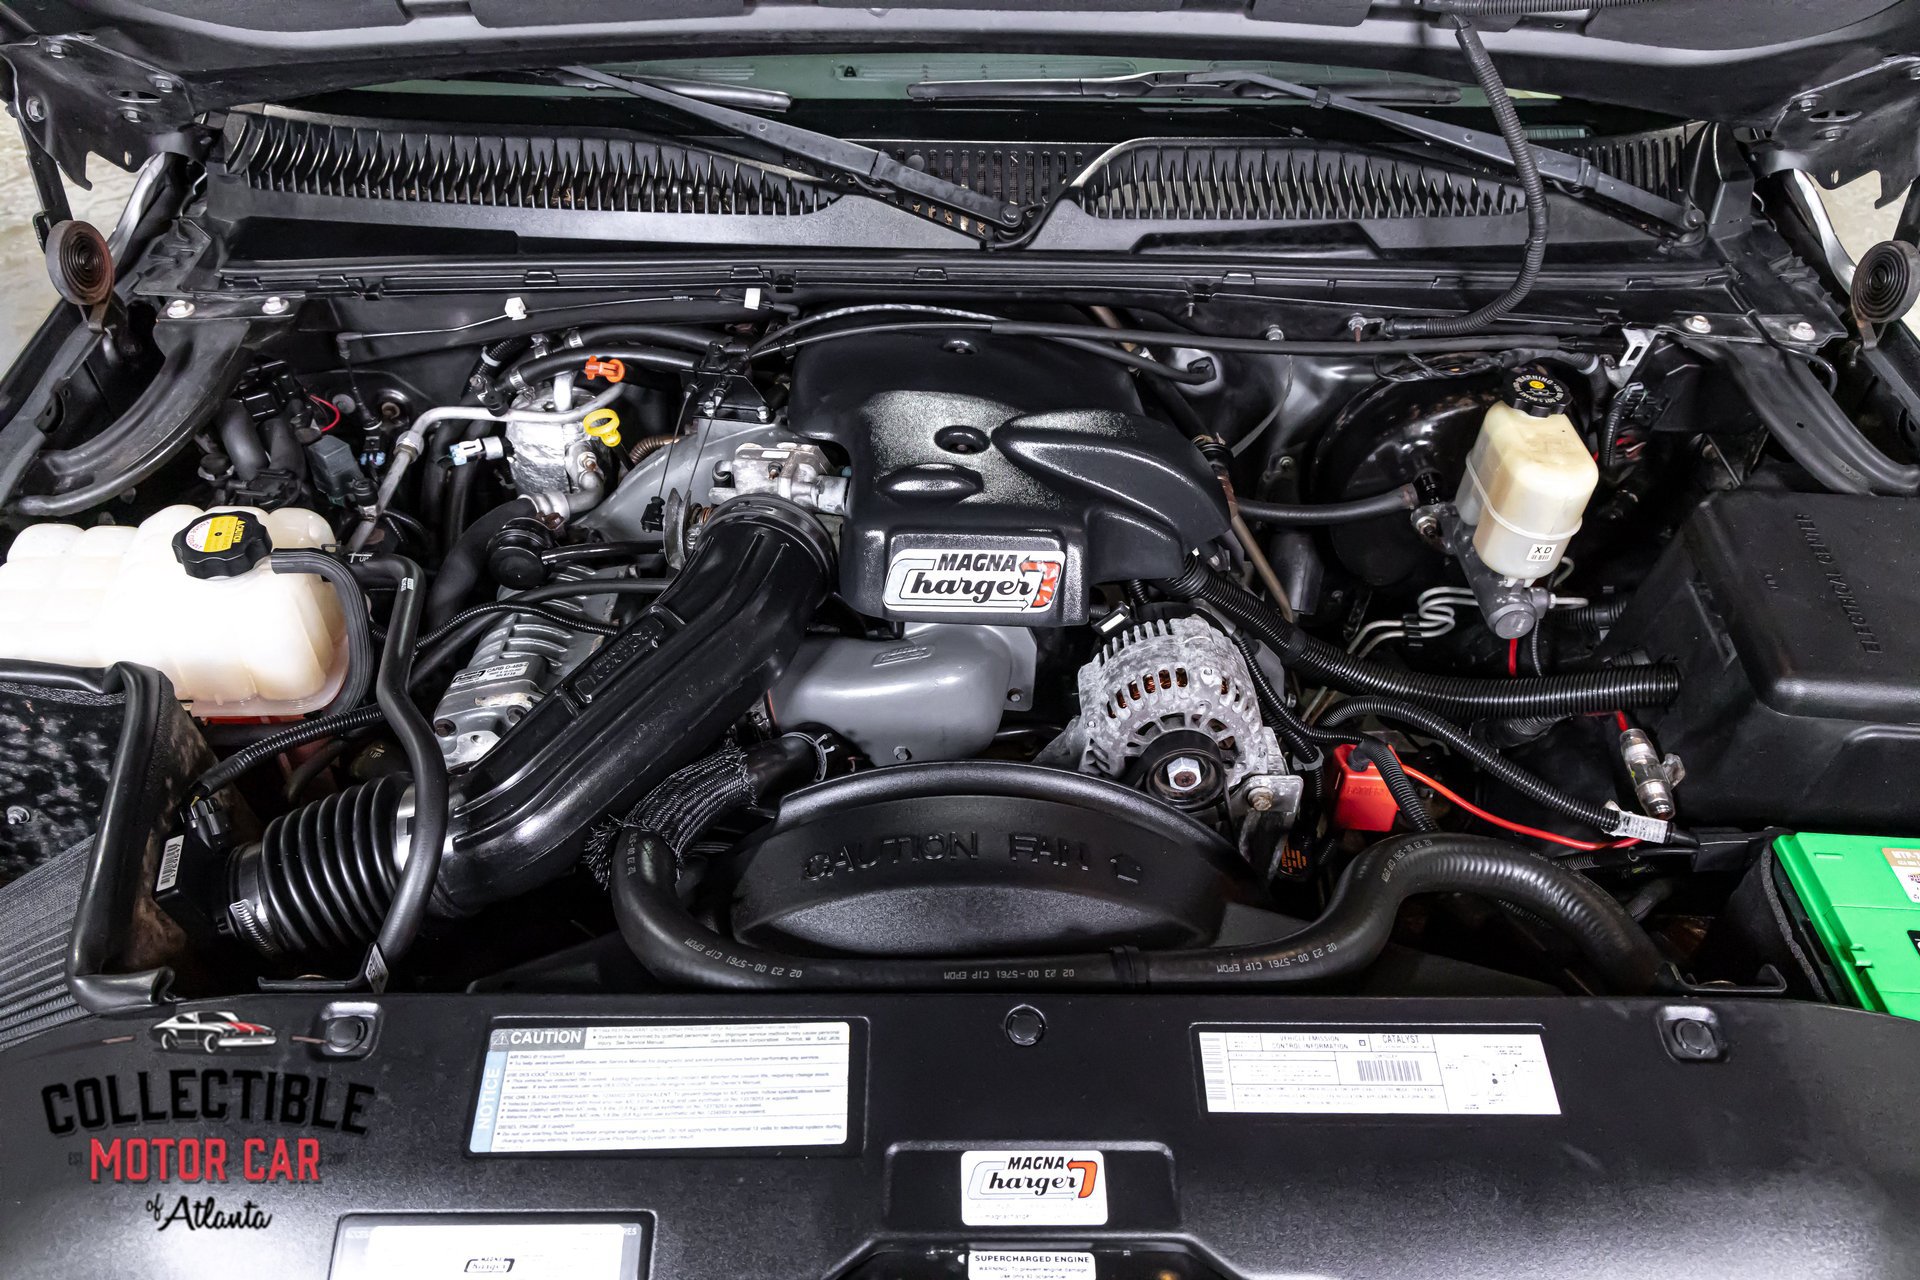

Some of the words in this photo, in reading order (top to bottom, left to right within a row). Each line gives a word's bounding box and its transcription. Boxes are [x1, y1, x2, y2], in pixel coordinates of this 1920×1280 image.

[936, 552, 1018, 572] MAGNA
[802, 830, 978, 882] CAUTION
[1008, 830, 1091, 872] FAN
[770, 966, 785, 976] 23
[789, 968, 803, 979] 02
[1044, 970, 1058, 979] 23
[1062, 968, 1076, 978] 02
[510, 1030, 582, 1045] CAUTION
[1382, 1034, 1420, 1044] CATALYST
[478, 1066, 502, 1130] NOTICE
[1007, 1156, 1064, 1170] MAGNA
